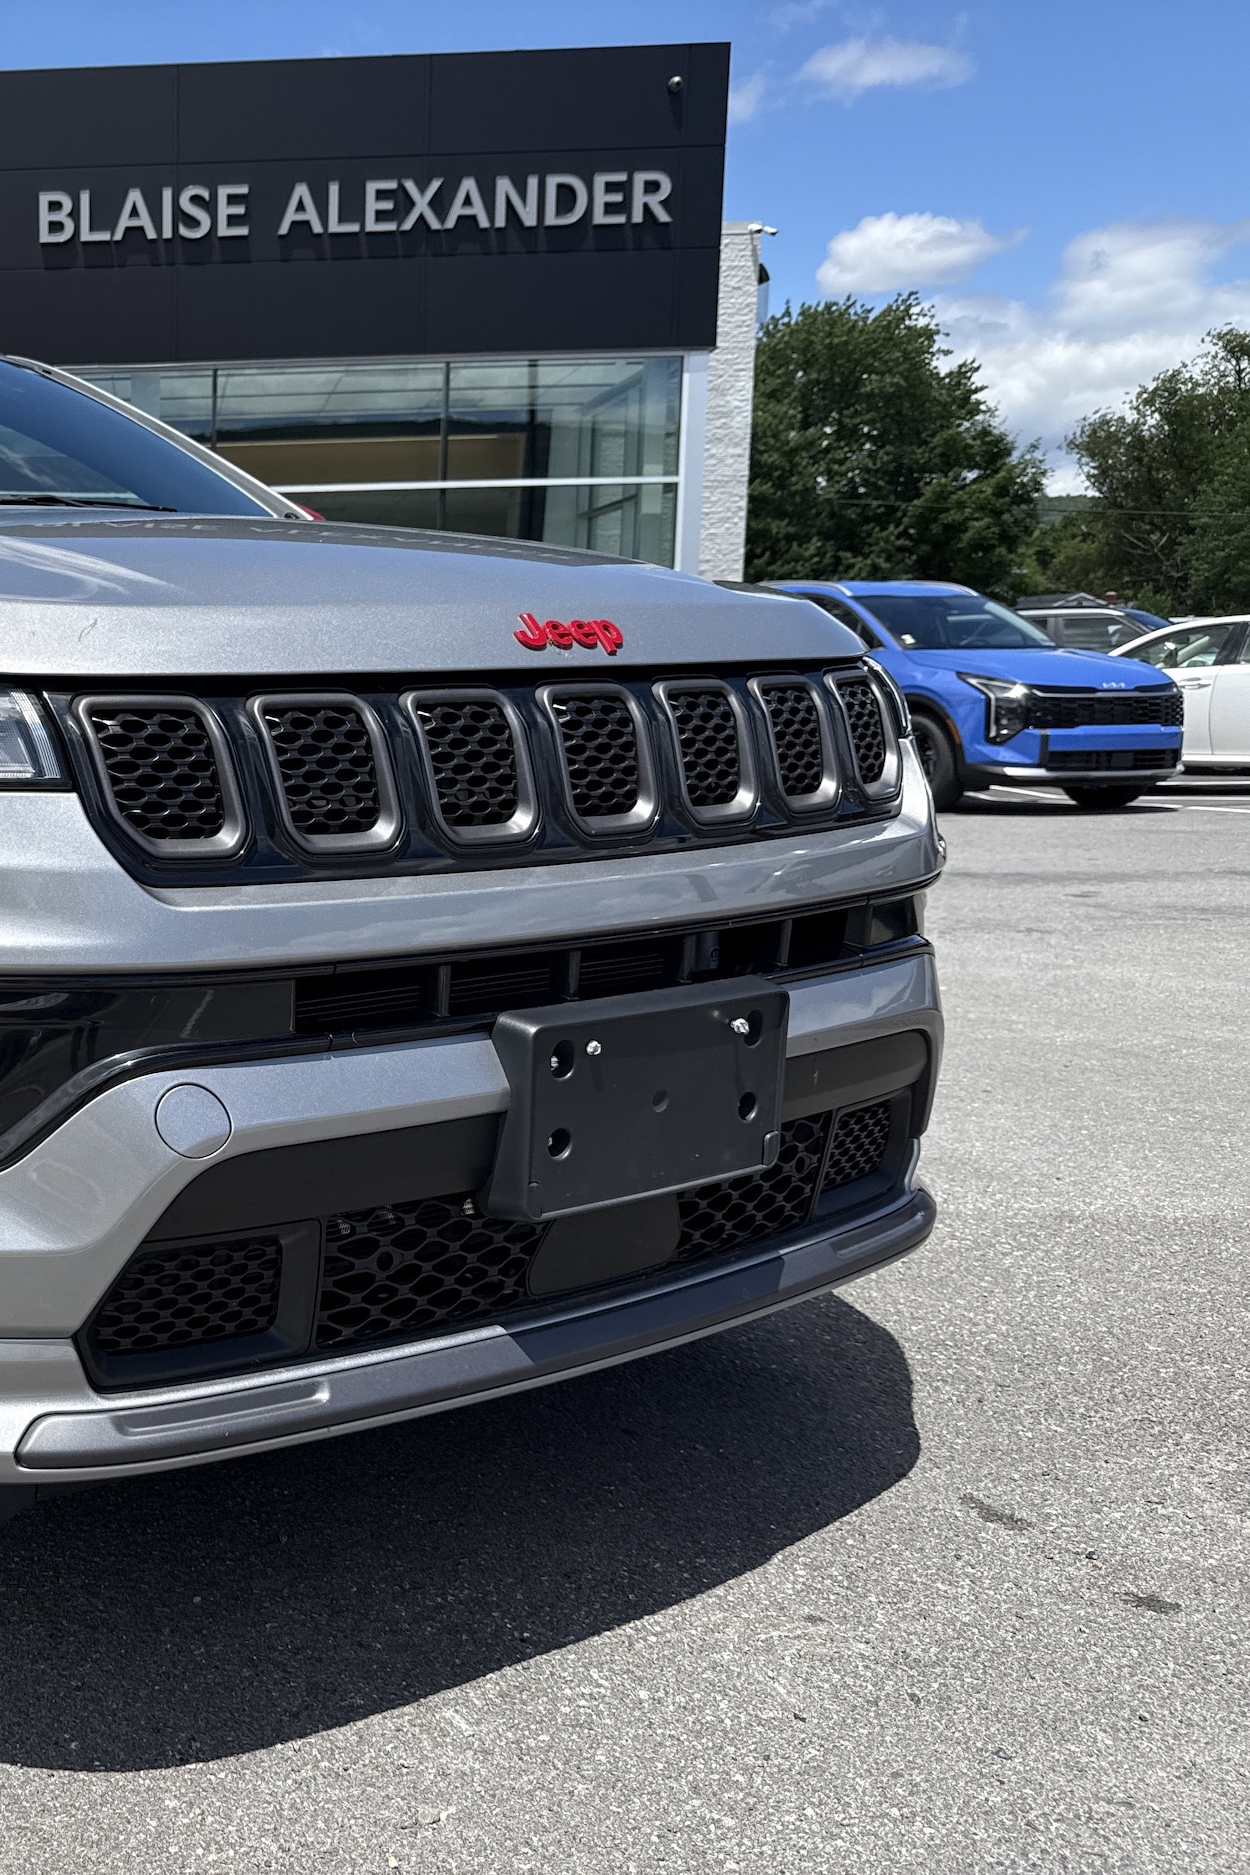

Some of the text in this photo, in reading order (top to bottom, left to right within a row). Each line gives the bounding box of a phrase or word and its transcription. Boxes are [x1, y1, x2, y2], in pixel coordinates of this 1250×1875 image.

[38, 170, 674, 244] BLAISE ALEXANDER
[513, 612, 624, 656] Jeep
